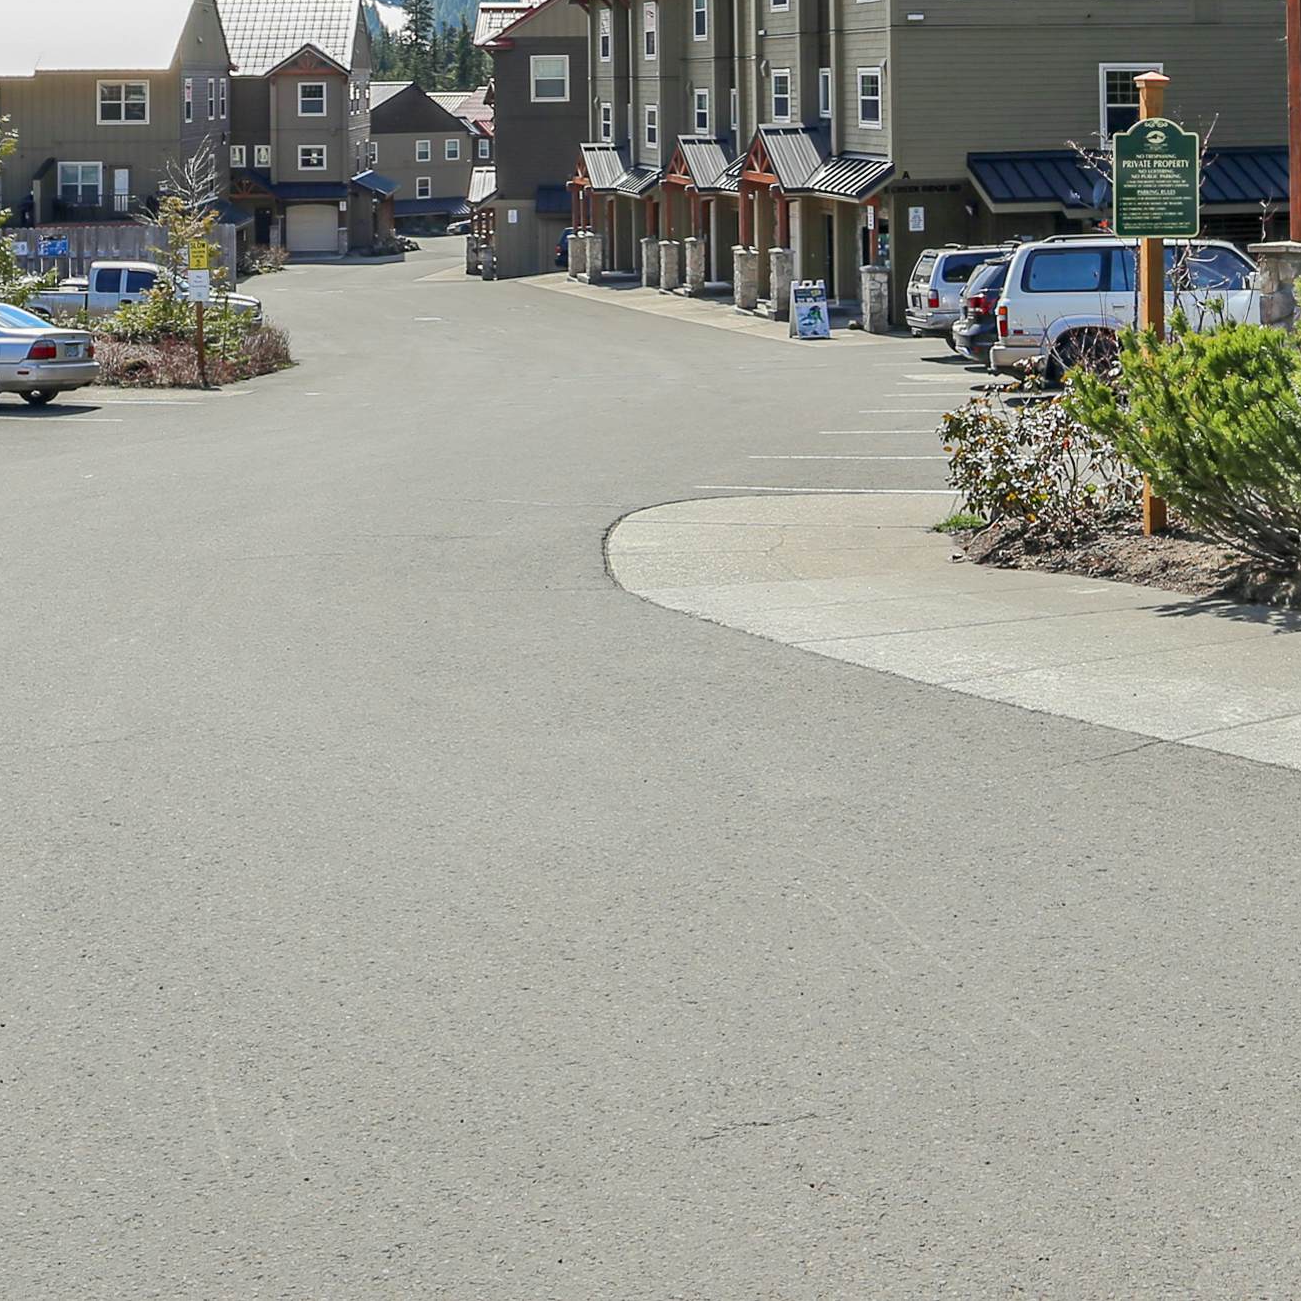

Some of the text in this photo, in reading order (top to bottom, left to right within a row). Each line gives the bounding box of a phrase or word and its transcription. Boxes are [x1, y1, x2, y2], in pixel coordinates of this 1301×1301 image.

[1122, 160, 1190, 168] PRIVATE PROPERTY
[902, 171, 910, 179] A
